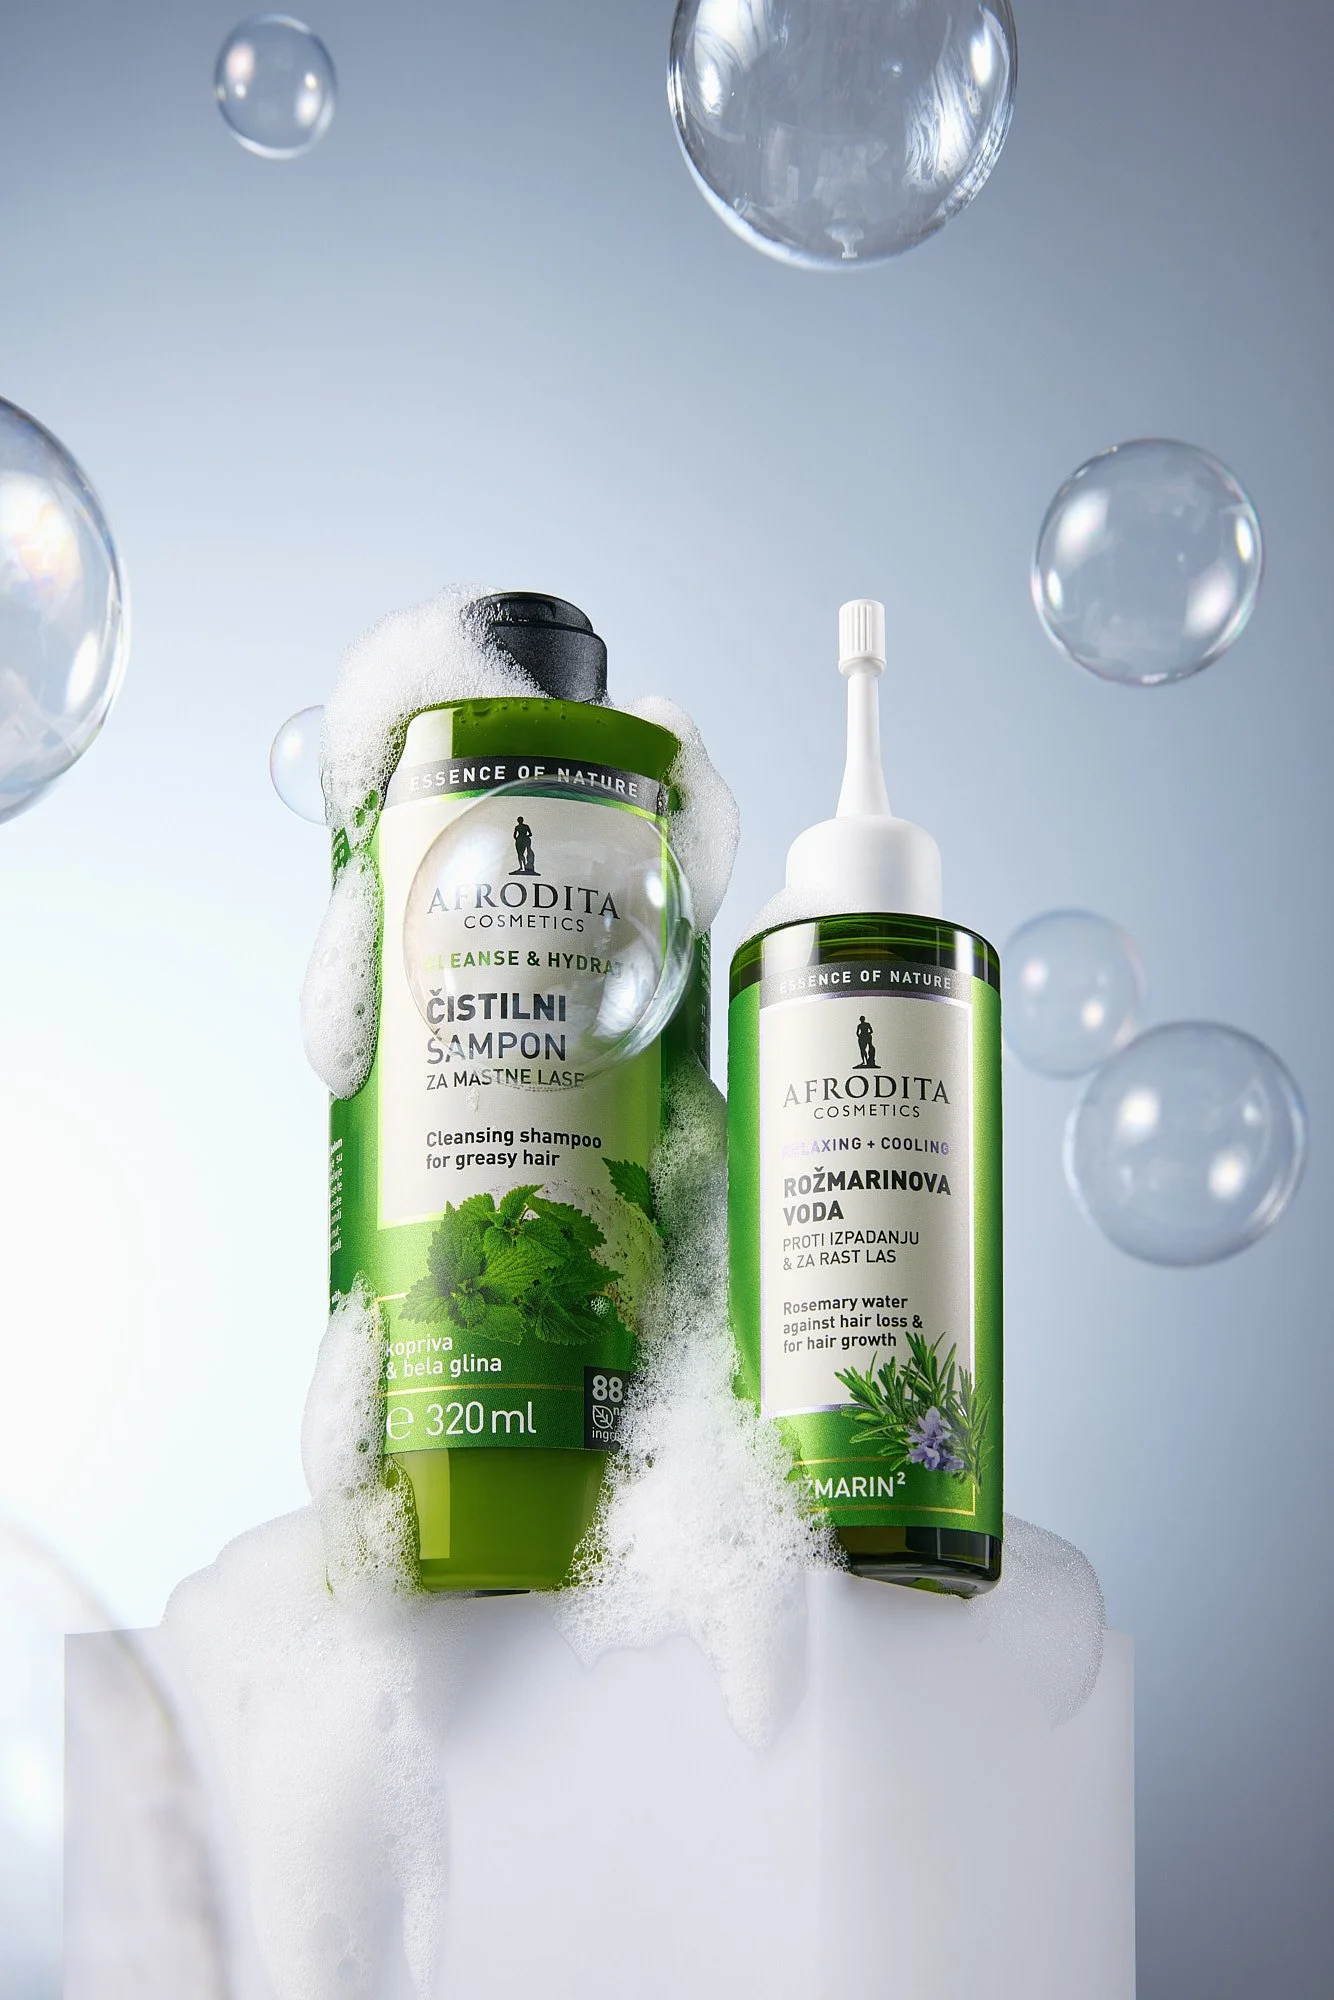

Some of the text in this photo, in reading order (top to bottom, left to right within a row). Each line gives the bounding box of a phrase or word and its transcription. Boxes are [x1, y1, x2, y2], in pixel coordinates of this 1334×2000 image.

[410, 765, 639, 798] ESSENCE OF NATURE
[426, 882, 621, 920] AFRODITA
[464, 914, 585, 932] COSMETICS
[424, 950, 520, 972] CLEANSE
[526, 951, 541, 967] &
[779, 969, 952, 994] ESSENCE OF NATURE
[426, 988, 567, 1025] ČISTILNI
[426, 1073, 448, 1091] ZA
[453, 1069, 532, 1088] MASTNE
[782, 1074, 951, 1108] AFRODITA
[813, 1103, 921, 1120] COSMETICS
[426, 1126, 602, 1150] Cleansing shampoo
[881, 1136, 950, 1156] COOLING
[425, 1149, 561, 1171] for greasy hair
[783, 1166, 952, 1199] ROŽMARINOVA
[783, 1200, 845, 1227] VODA
[783, 1230, 920, 1252] PROTI IZPADANJU
[783, 1249, 897, 1271] & ZA RAST LAS
[783, 1295, 909, 1316] Rosemary water
[783, 1313, 924, 1336] against hair loss &
[386, 1333, 453, 1359] kopriva
[783, 1332, 898, 1354] for hair growth
[385, 1353, 502, 1380] & bela glina
[592, 1374, 624, 1403] 88
[425, 1400, 485, 1437] 320
[491, 1400, 537, 1435] ml
